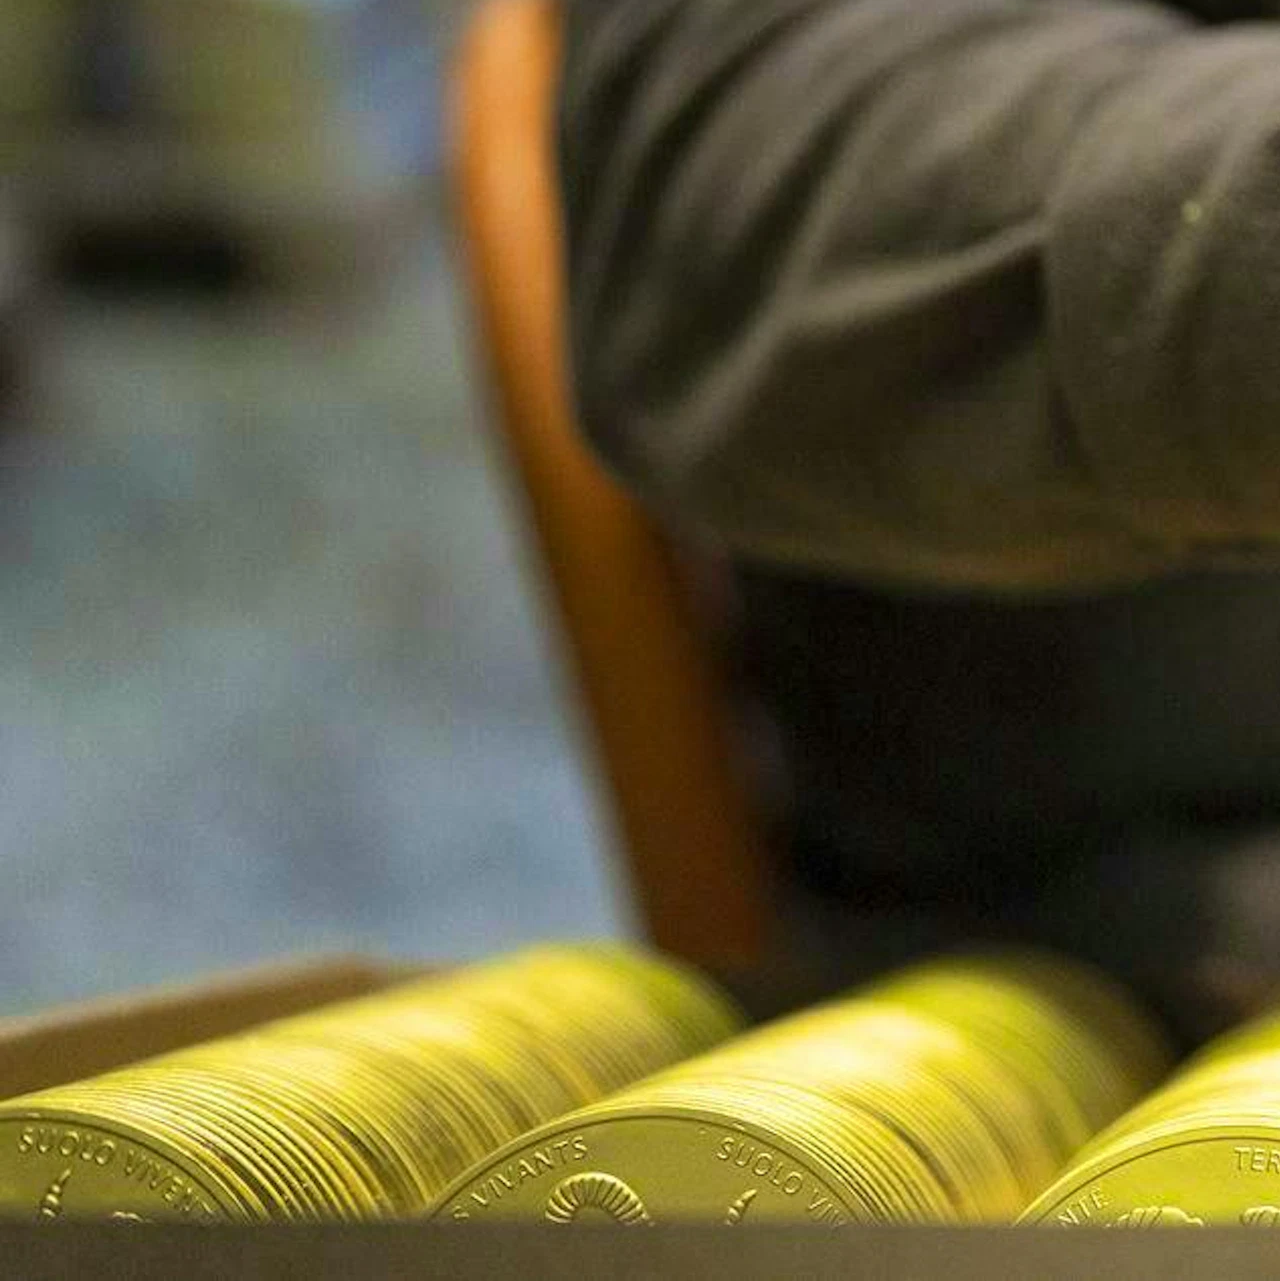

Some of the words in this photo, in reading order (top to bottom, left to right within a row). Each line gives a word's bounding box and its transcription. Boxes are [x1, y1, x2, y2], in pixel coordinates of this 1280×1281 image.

[18, 1126, 116, 1165] SUOLO
[470, 1135, 588, 1208] VIVANTS
[715, 1136, 803, 1195] SUOLO
